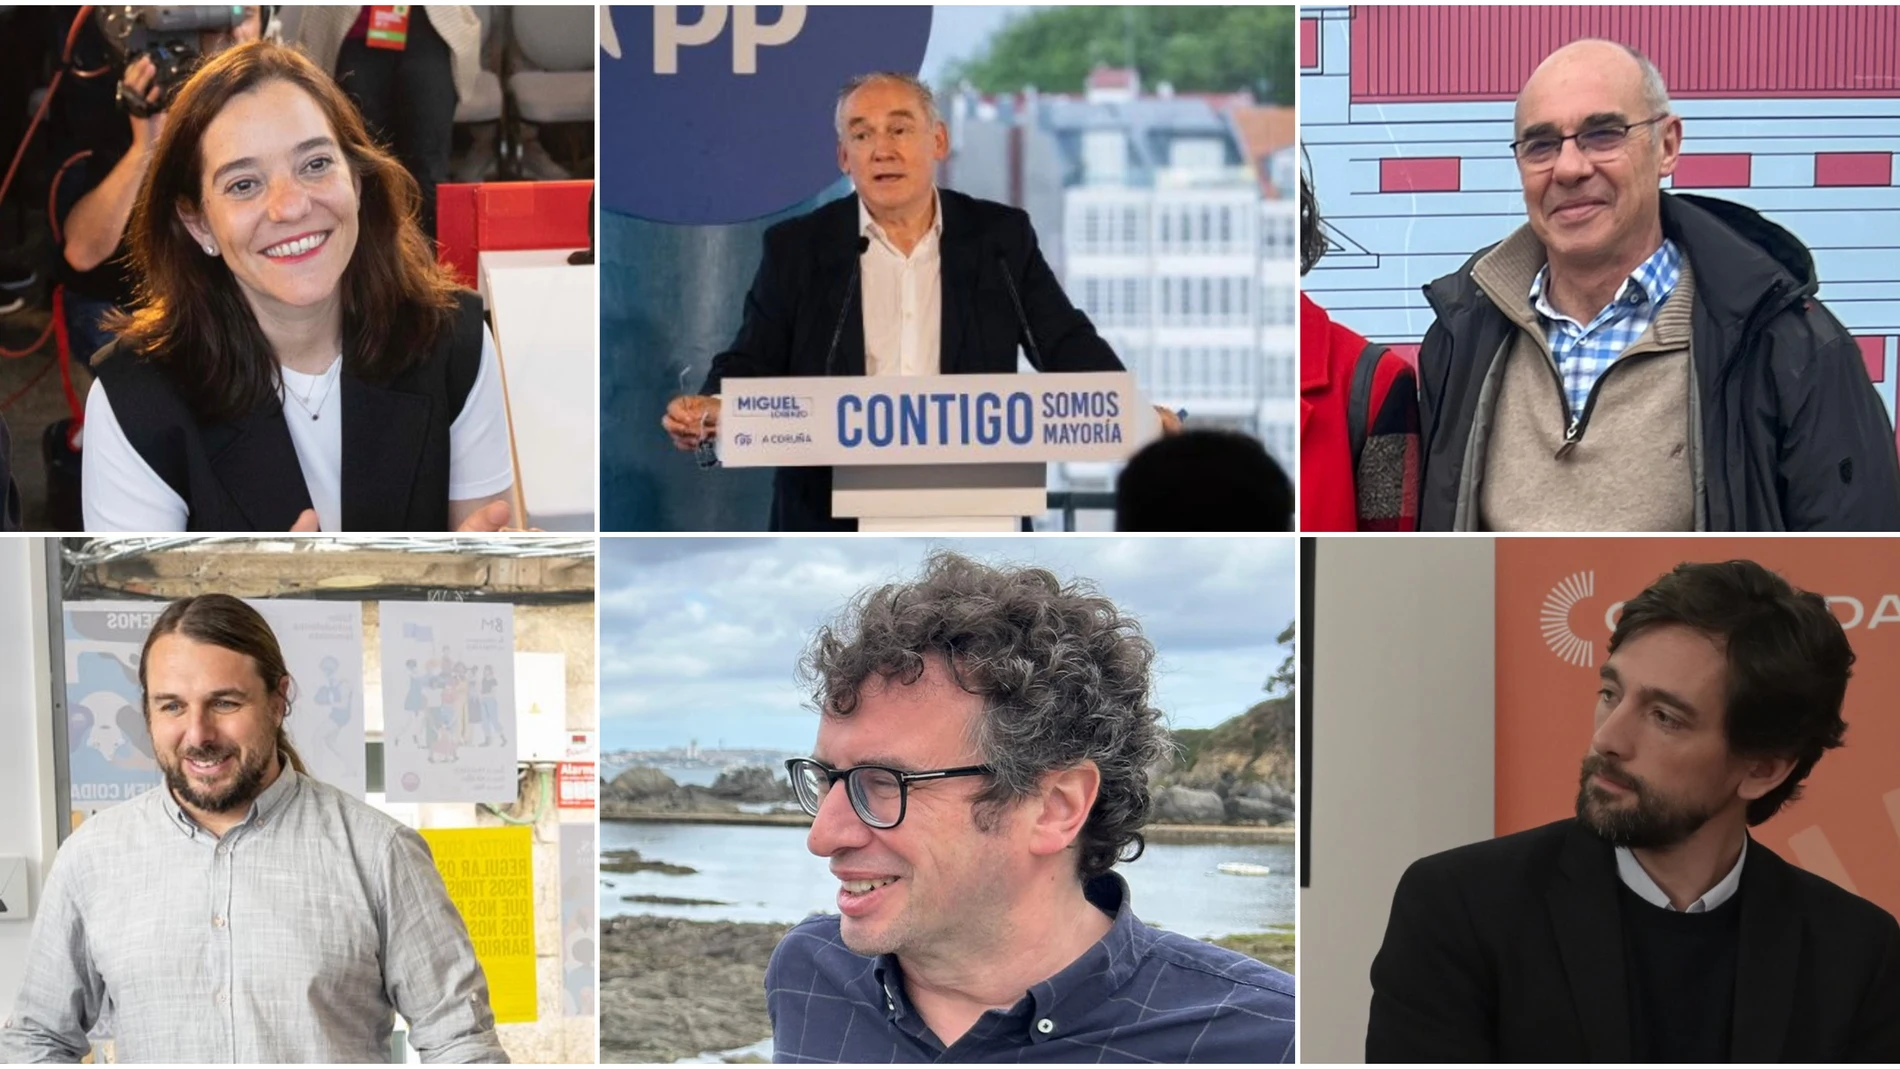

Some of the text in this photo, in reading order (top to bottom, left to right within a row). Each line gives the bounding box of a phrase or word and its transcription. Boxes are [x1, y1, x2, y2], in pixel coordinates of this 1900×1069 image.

[738, 396, 800, 410] MIGUEL
[1042, 391, 1119, 418] SOMOS
[837, 392, 1033, 447] CONTIGO
[1043, 418, 1122, 444] MAYORÍA
